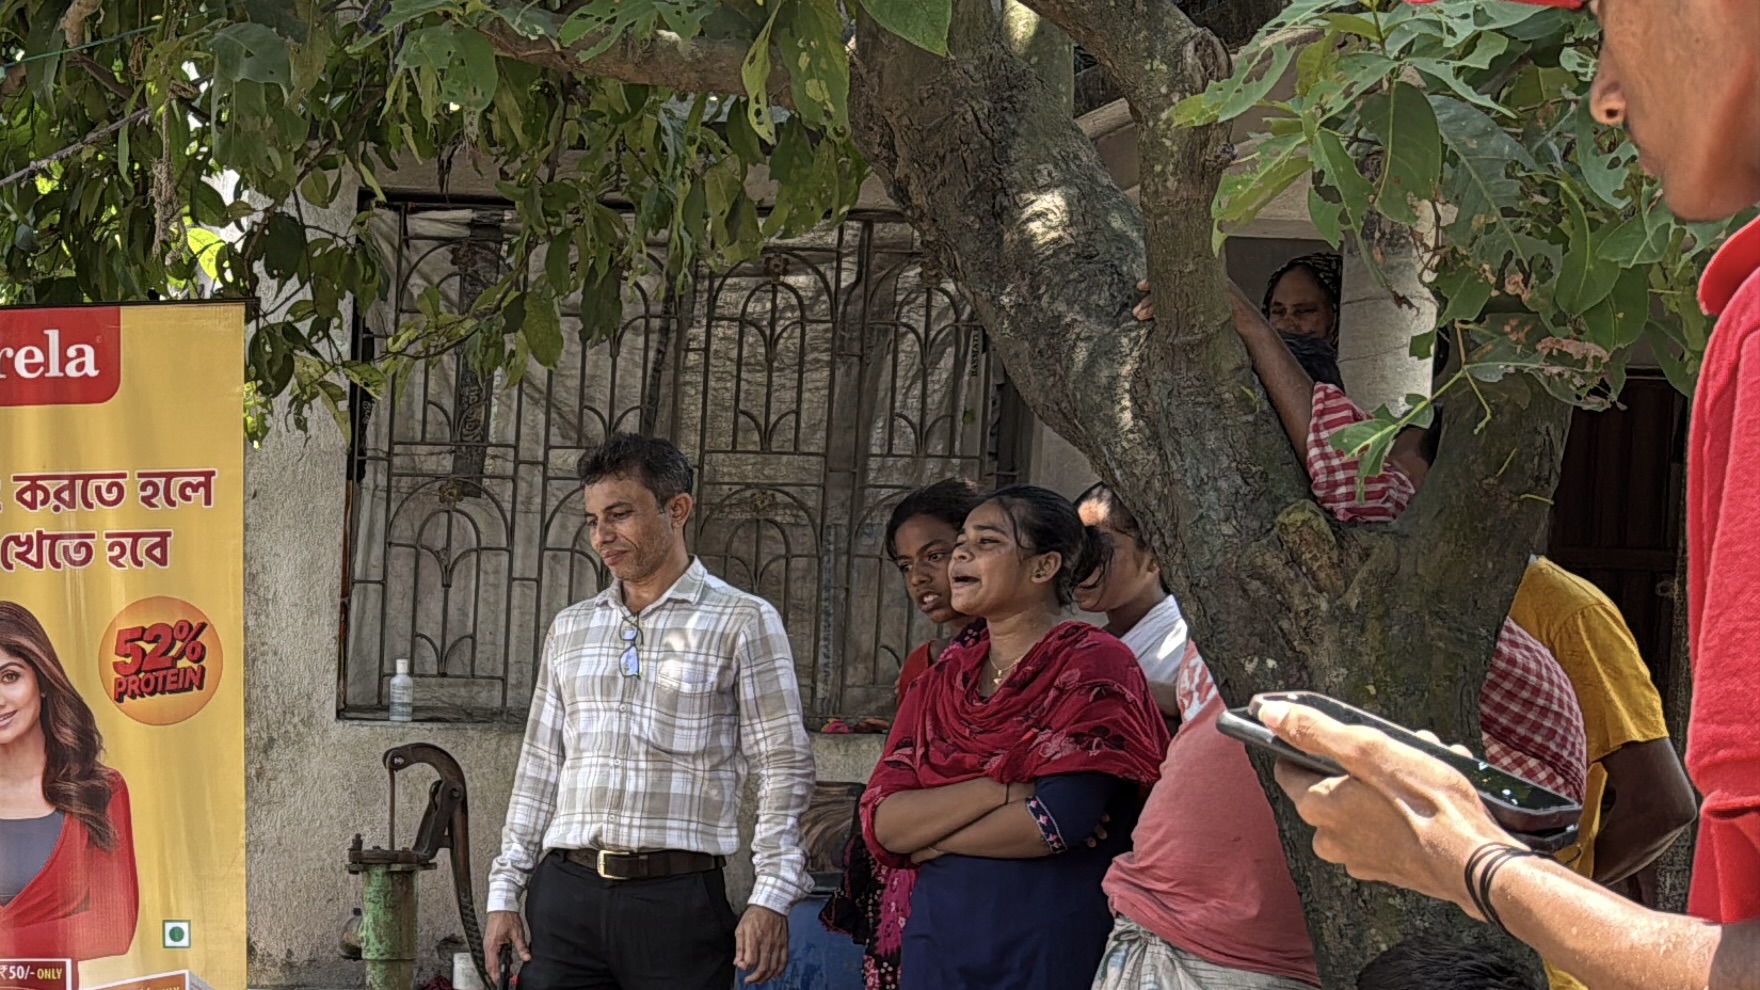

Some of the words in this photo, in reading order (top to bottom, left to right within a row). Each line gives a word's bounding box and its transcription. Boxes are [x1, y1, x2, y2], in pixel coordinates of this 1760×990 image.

[12, 472, 128, 513] করতে
[136, 469, 216, 508] হলে
[0, 529, 97, 571] খেতে
[104, 530, 173, 568] হবে
[112, 619, 208, 677] 52%
[113, 664, 206, 703] PROTEIN
[37, 968, 62, 980] ONLY
